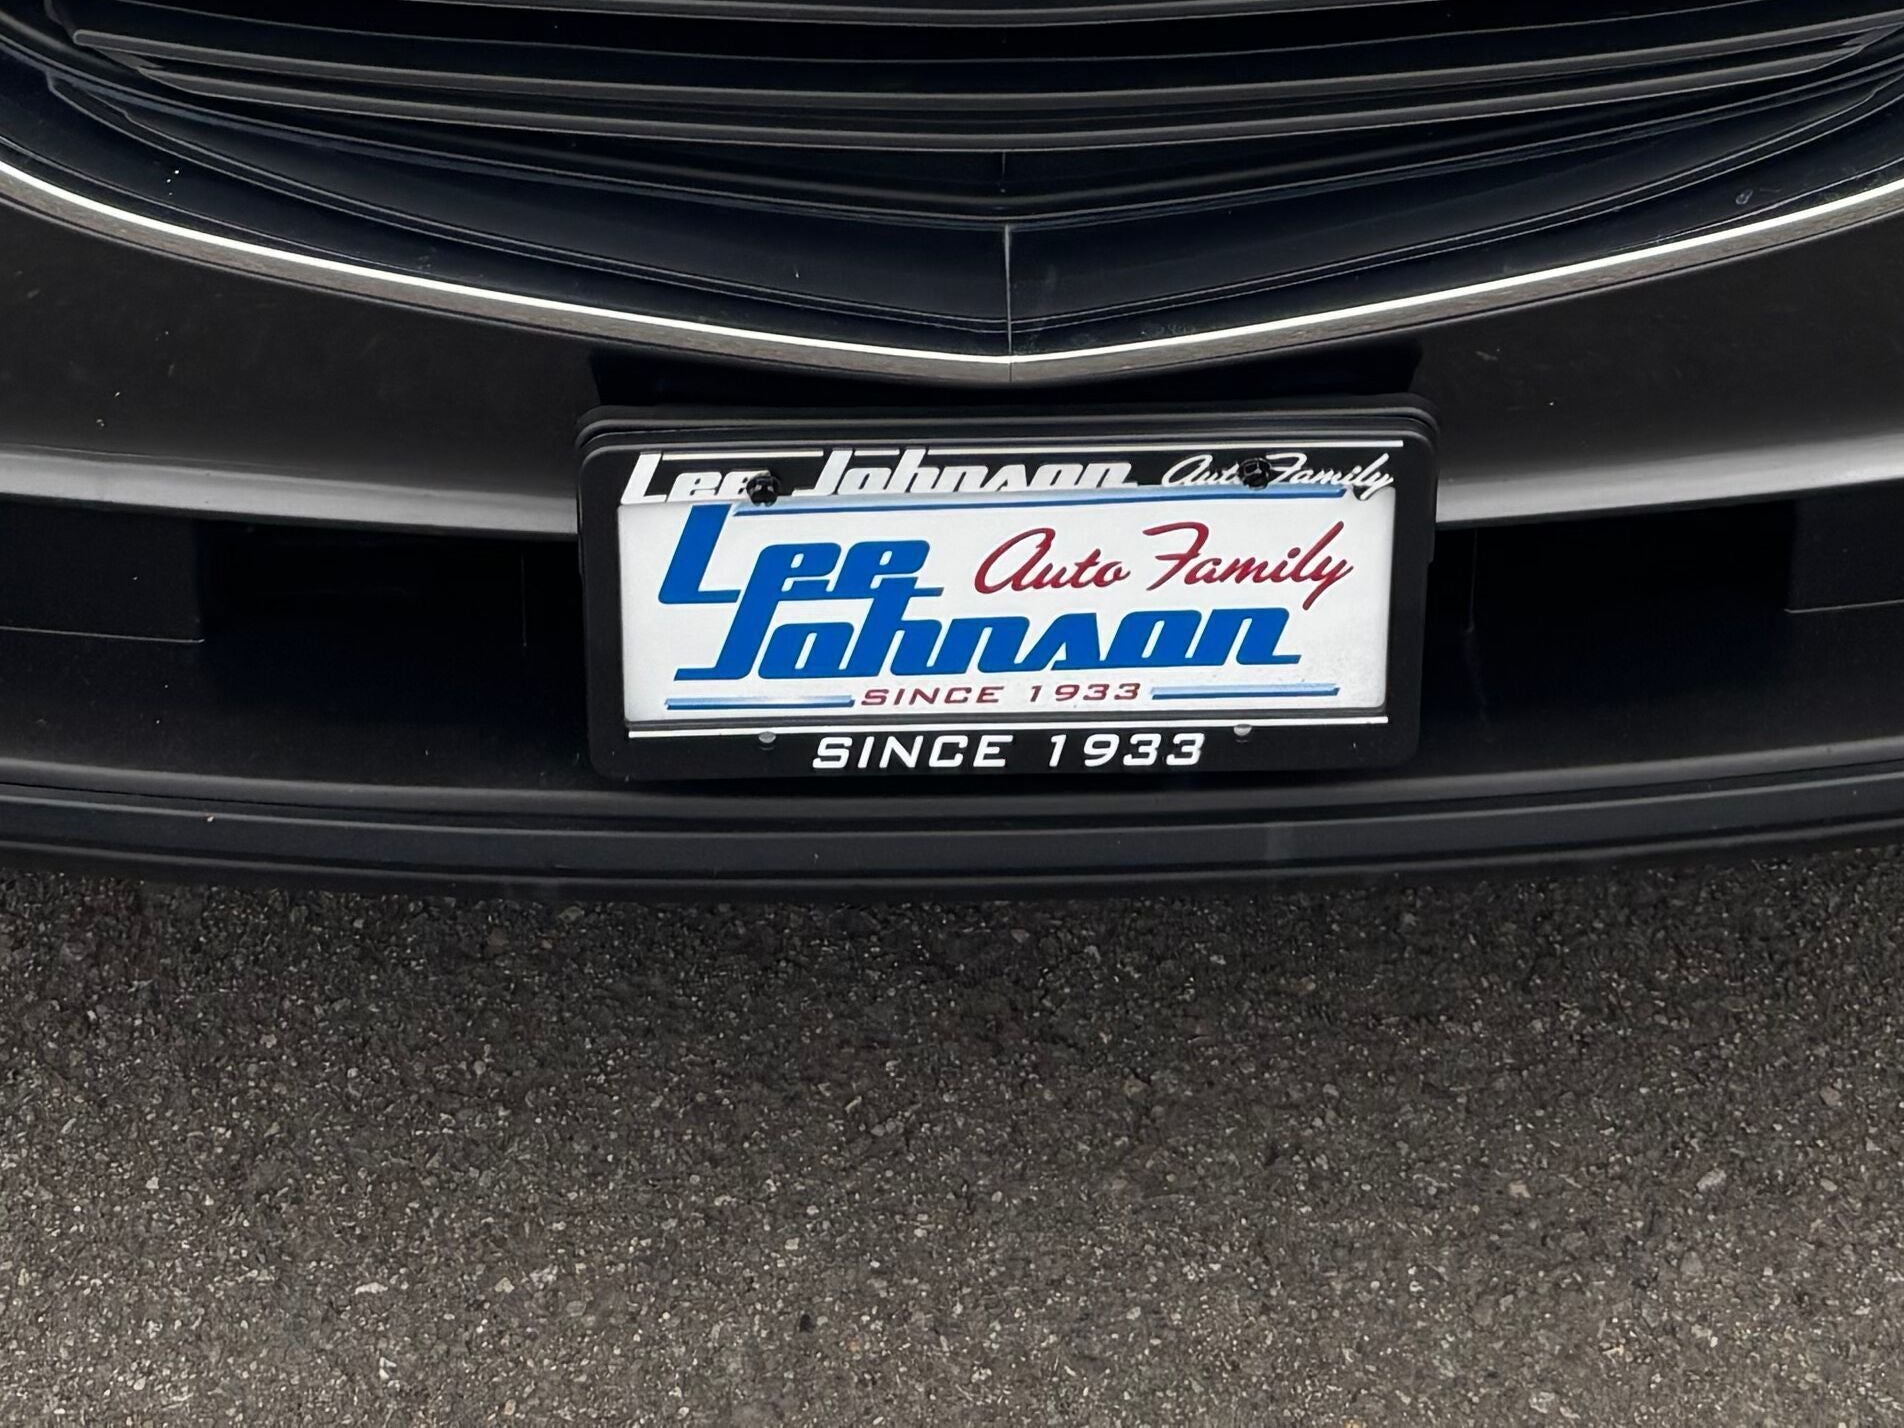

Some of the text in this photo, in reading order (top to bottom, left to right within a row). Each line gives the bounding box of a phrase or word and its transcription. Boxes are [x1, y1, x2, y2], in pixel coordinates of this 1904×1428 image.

[792, 447, 1138, 495] Johnson
[1161, 454, 1258, 486] Aut
[1264, 452, 1394, 501] Family
[658, 504, 1355, 611] Lee Auto Family
[674, 584, 1302, 681] Johnson
[860, 682, 1142, 707] SINCE 1933
[812, 732, 1205, 769] SINCE 1933
